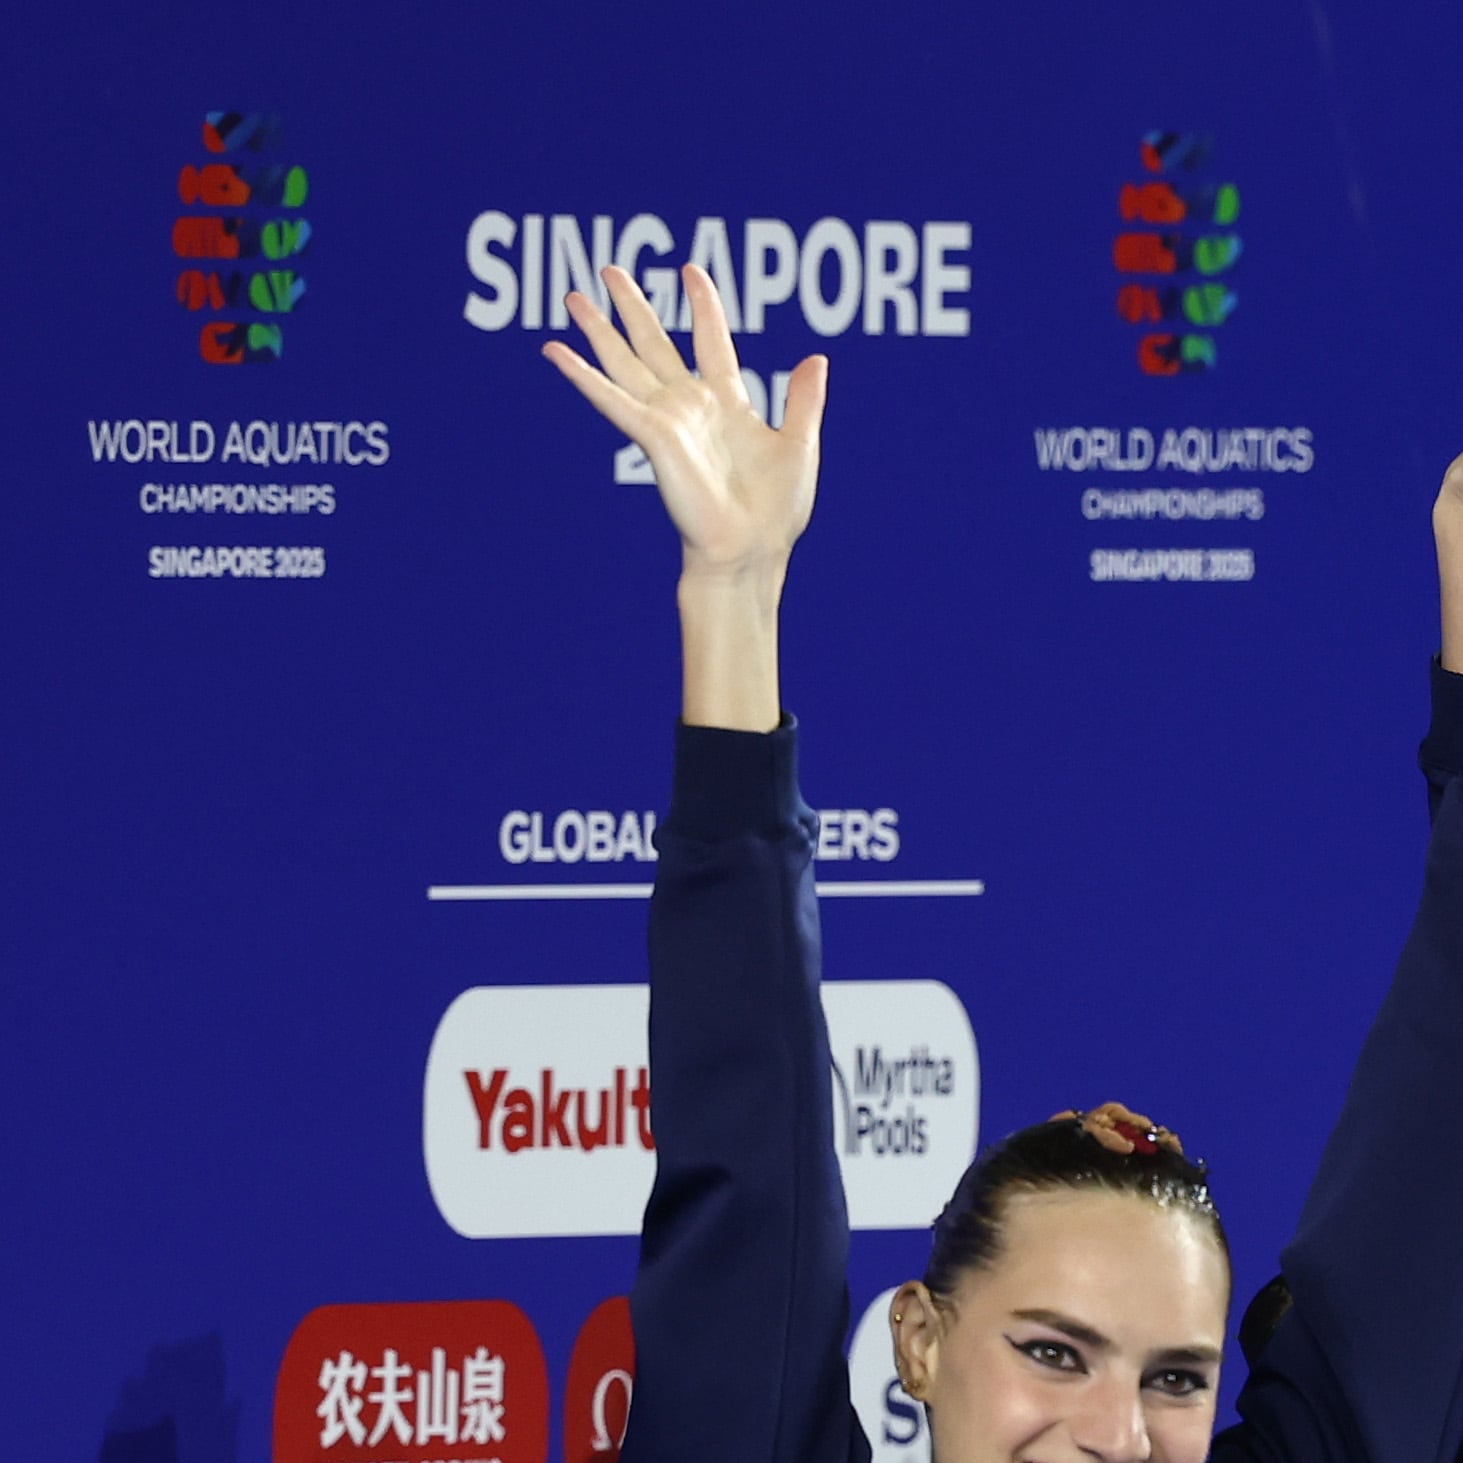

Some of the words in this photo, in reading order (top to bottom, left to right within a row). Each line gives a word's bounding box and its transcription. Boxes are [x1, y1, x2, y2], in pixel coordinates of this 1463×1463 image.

[464, 209, 972, 337] SINGAPORE
[88, 420, 215, 463] WORLD
[221, 420, 389, 467] AQUATICS
[1034, 427, 1154, 472] WORLD
[1156, 427, 1314, 474] AQUATICS
[140, 483, 336, 514] CHAMPIONSHIPS
[148, 546, 273, 577] SINGAPORE
[500, 810, 659, 863] GLOBAL
[815, 808, 900, 860] ERS
[463, 1067, 656, 1153] Yakult
[316, 1346, 505, 1448] 农夫山泉
